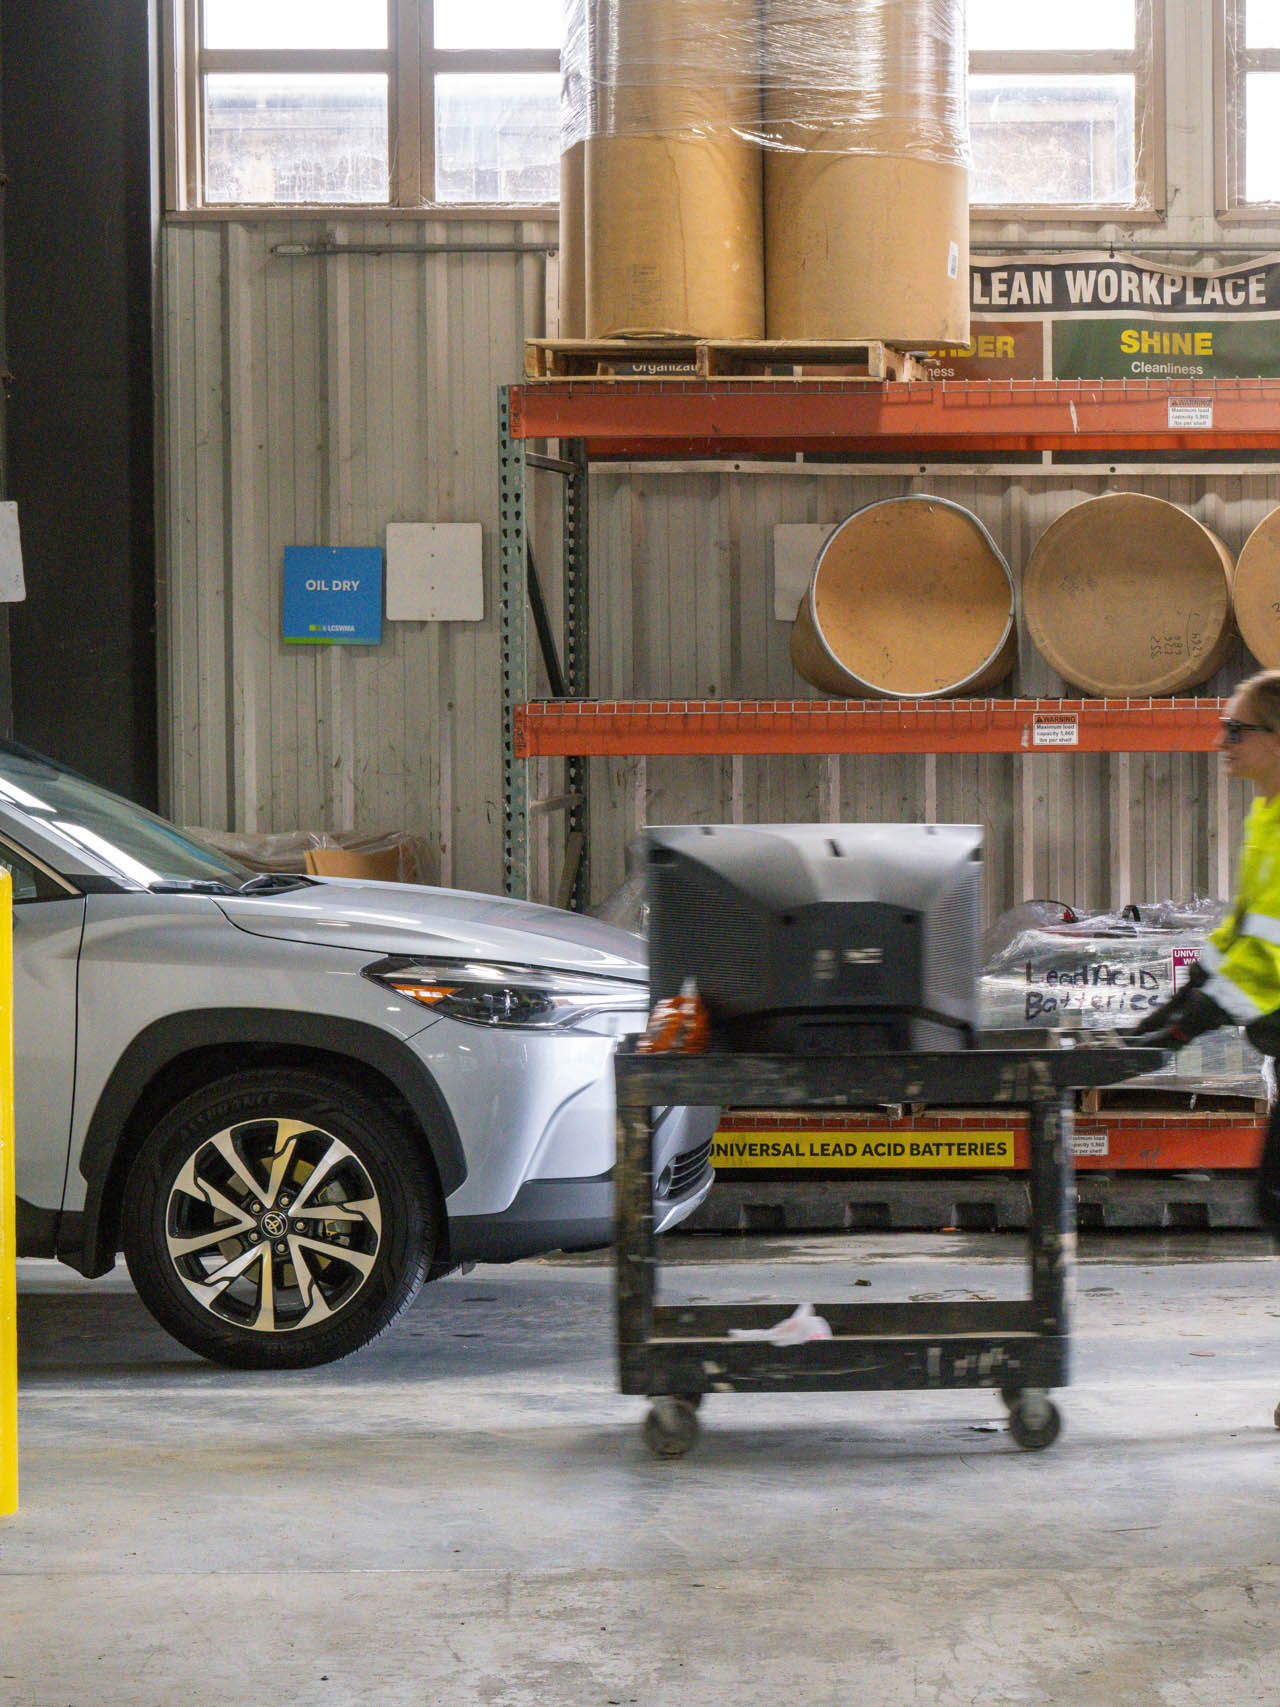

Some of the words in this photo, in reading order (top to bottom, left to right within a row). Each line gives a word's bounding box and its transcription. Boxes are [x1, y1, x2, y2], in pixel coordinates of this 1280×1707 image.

[1065, 269, 1267, 306] WORKPLACE
[928, 335, 1016, 358] DER
[1120, 330, 1214, 356] SHINE
[1131, 360, 1204, 376] Cleanliness
[305, 579, 329, 591] OIL
[332, 580, 360, 591] DRY
[1043, 715, 1076, 723] WARNING
[809, 1142, 858, 1157] LEAD
[861, 1142, 906, 1157] ACID
[909, 1142, 1007, 1157] BATTERIES
